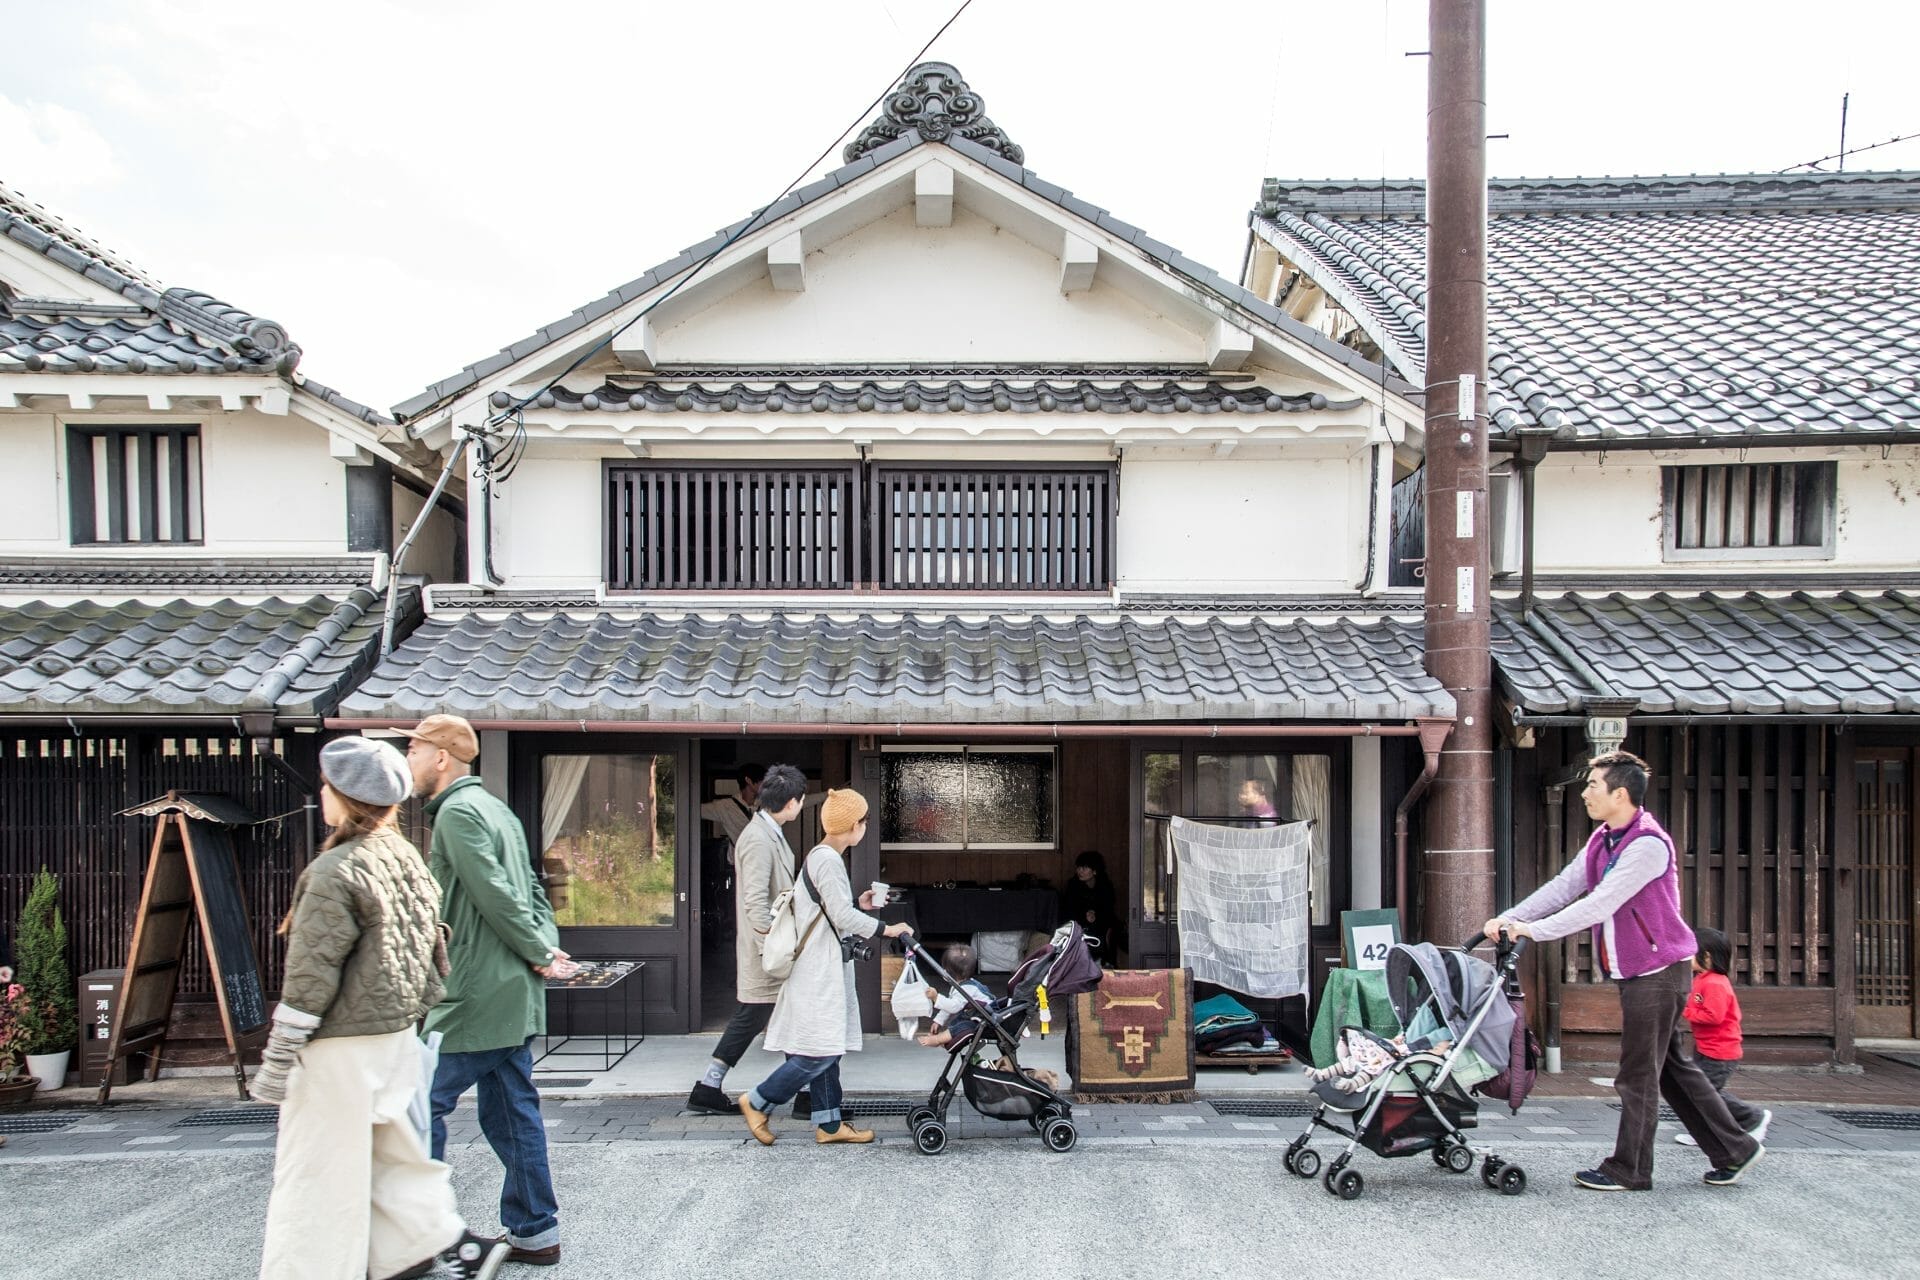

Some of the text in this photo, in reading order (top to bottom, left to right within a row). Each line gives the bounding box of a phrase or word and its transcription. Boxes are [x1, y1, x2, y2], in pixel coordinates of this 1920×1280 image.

[1362, 943, 1388, 961] 42
[96, 999, 110, 1039] 消火器
